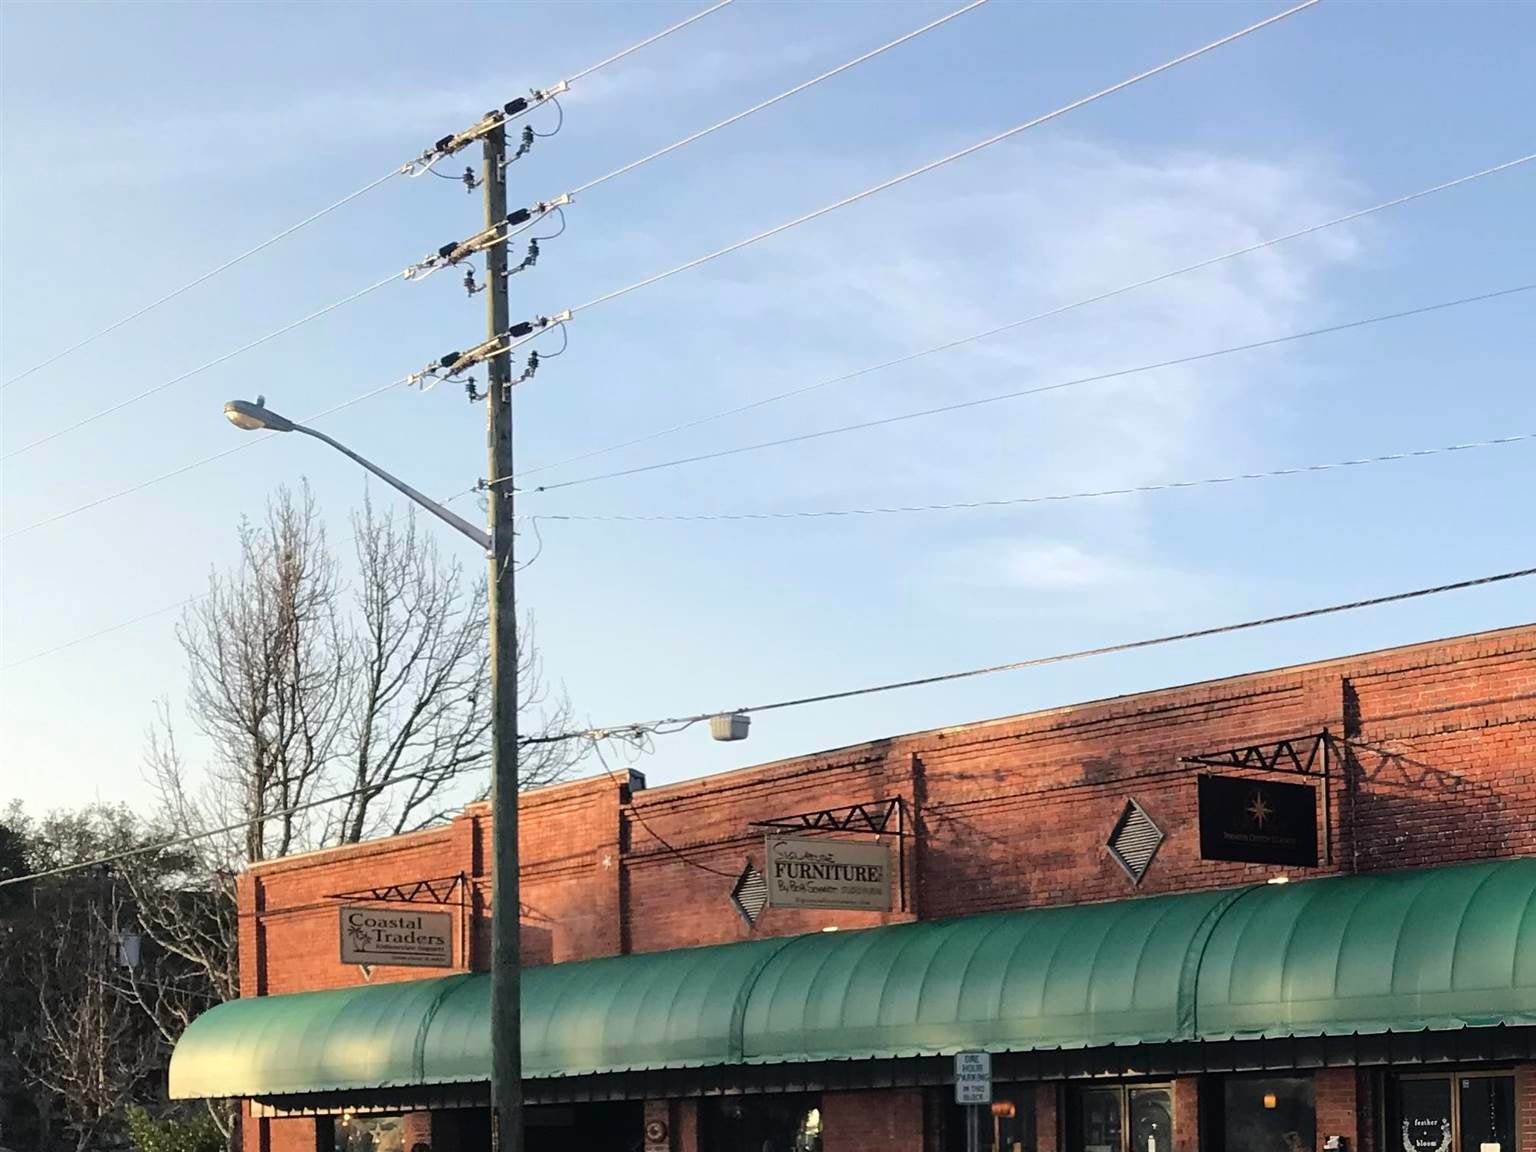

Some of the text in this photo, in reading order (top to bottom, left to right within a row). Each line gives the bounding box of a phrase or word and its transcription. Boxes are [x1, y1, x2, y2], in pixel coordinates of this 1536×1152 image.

[775, 863, 878, 882] FURNITURE
[348, 913, 422, 930] Coastal
[373, 929, 445, 945] Traders
[1414, 1118, 1438, 1126] feather
[1416, 1139, 1437, 1147] bloom
